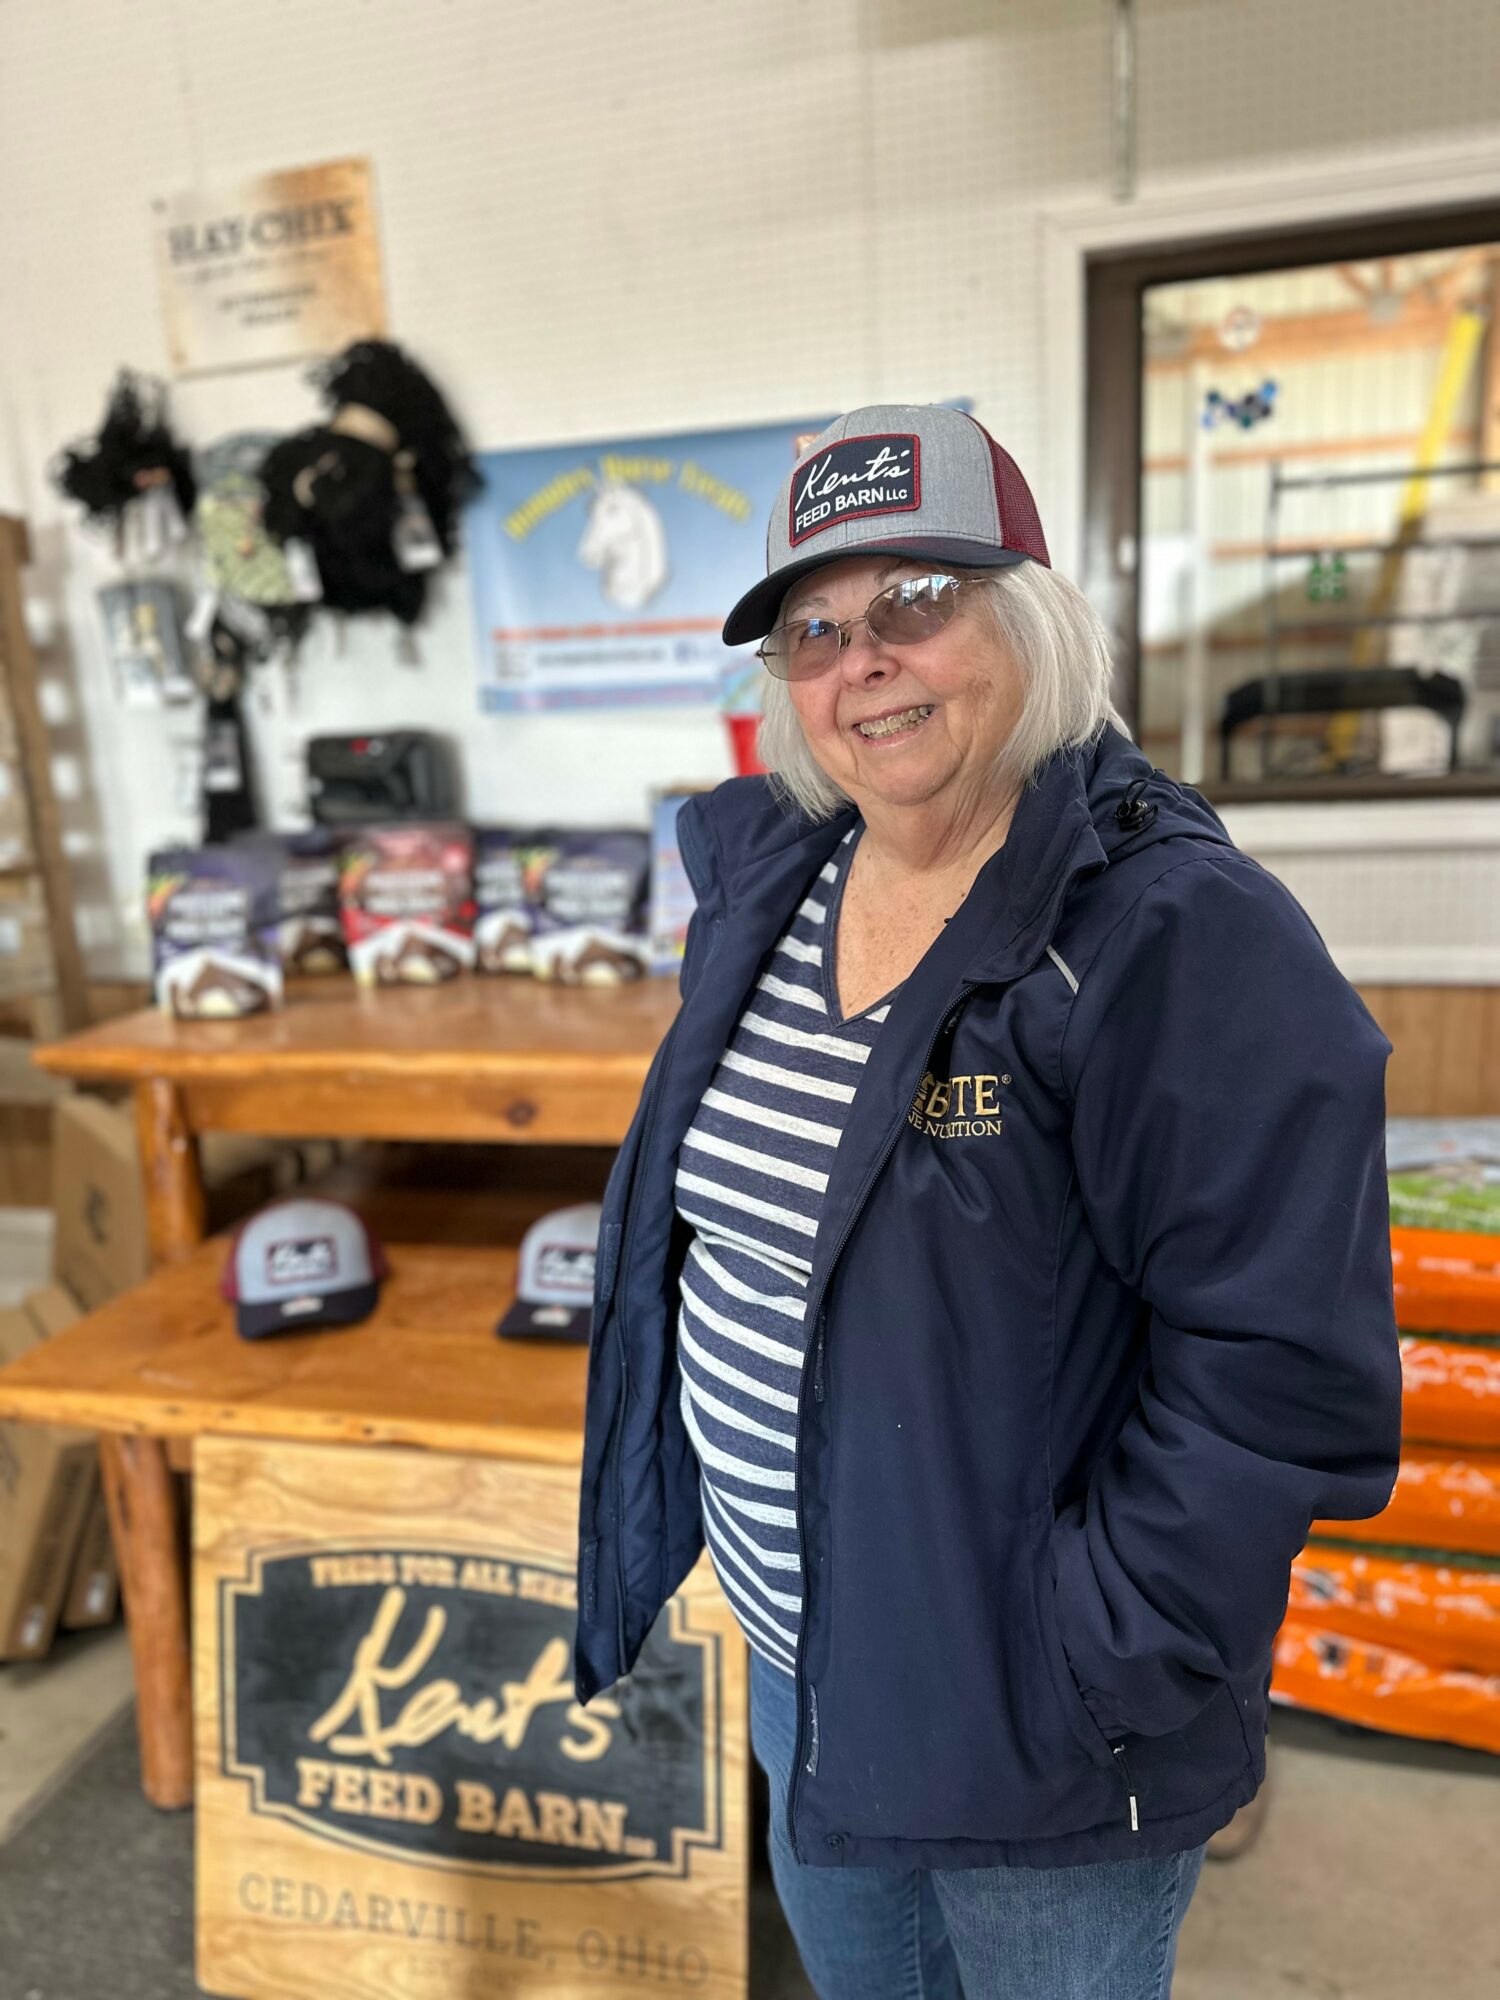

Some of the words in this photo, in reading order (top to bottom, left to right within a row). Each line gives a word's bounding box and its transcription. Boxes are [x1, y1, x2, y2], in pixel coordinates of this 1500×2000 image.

[794, 446, 911, 511] Kent's
[795, 501, 831, 533] FEED
[835, 486, 884, 512] BARN
[886, 489, 908, 501] LLC
[459, 1559, 516, 1596] ALL
[308, 1586, 622, 1766] Kents
[296, 1757, 443, 1826] FEED
[454, 1780, 628, 1854] BARN
[238, 1872, 558, 1970] CEDARVILLE,
[577, 1928, 710, 1988] OHIO
